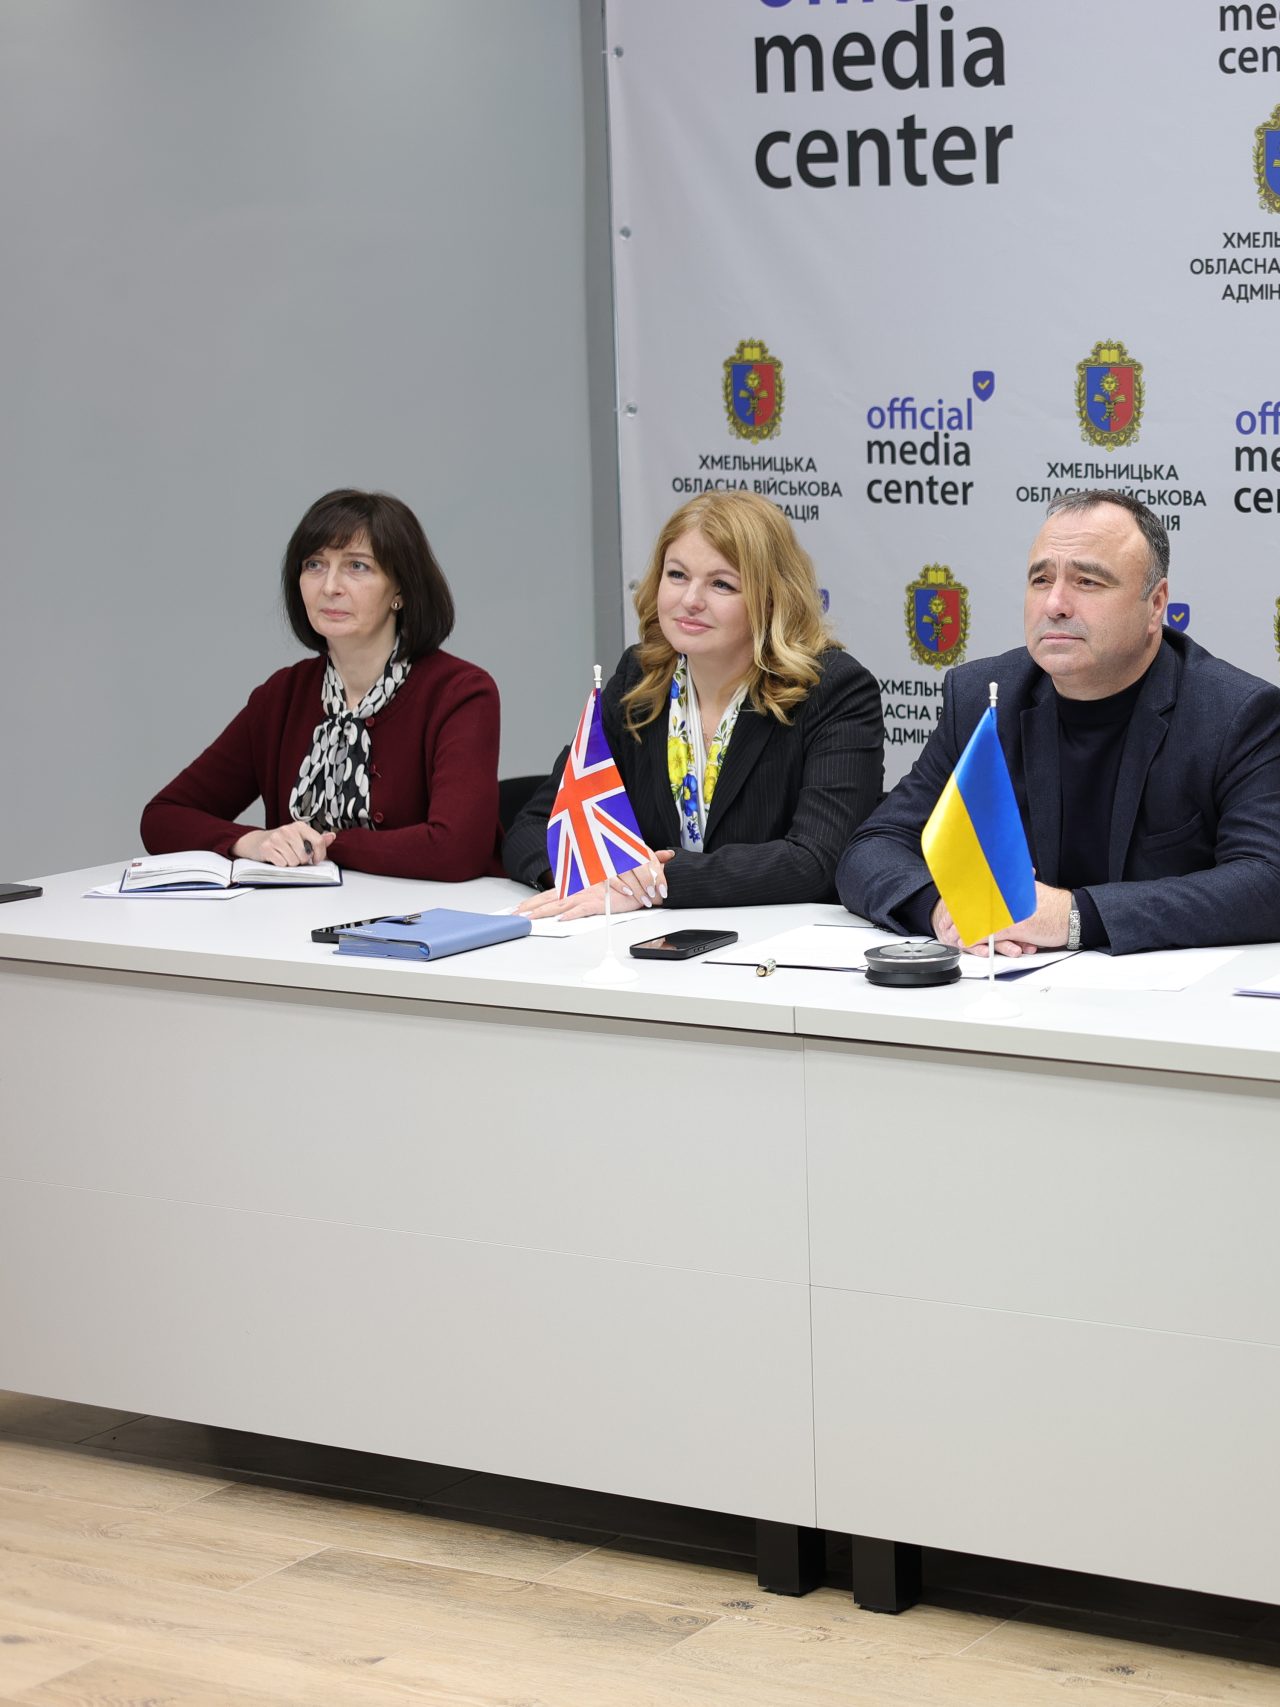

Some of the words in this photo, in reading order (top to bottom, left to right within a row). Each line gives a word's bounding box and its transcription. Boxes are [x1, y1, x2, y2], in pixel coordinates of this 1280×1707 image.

[754, 3, 1006, 94] media
[754, 114, 1014, 190] center
[866, 396, 974, 432] official
[866, 431, 971, 467] media
[699, 454, 817, 475] ХМЕЛЬНИЦЬКА
[1047, 462, 1179, 483] ХМЕЛЬНИЦЬКА
[754, 477, 843, 497] ВІЙСЬКОВА
[866, 475, 974, 506] center
[879, 678, 944, 698] ХМЕЛЬН
[883, 703, 931, 720] АСНА
